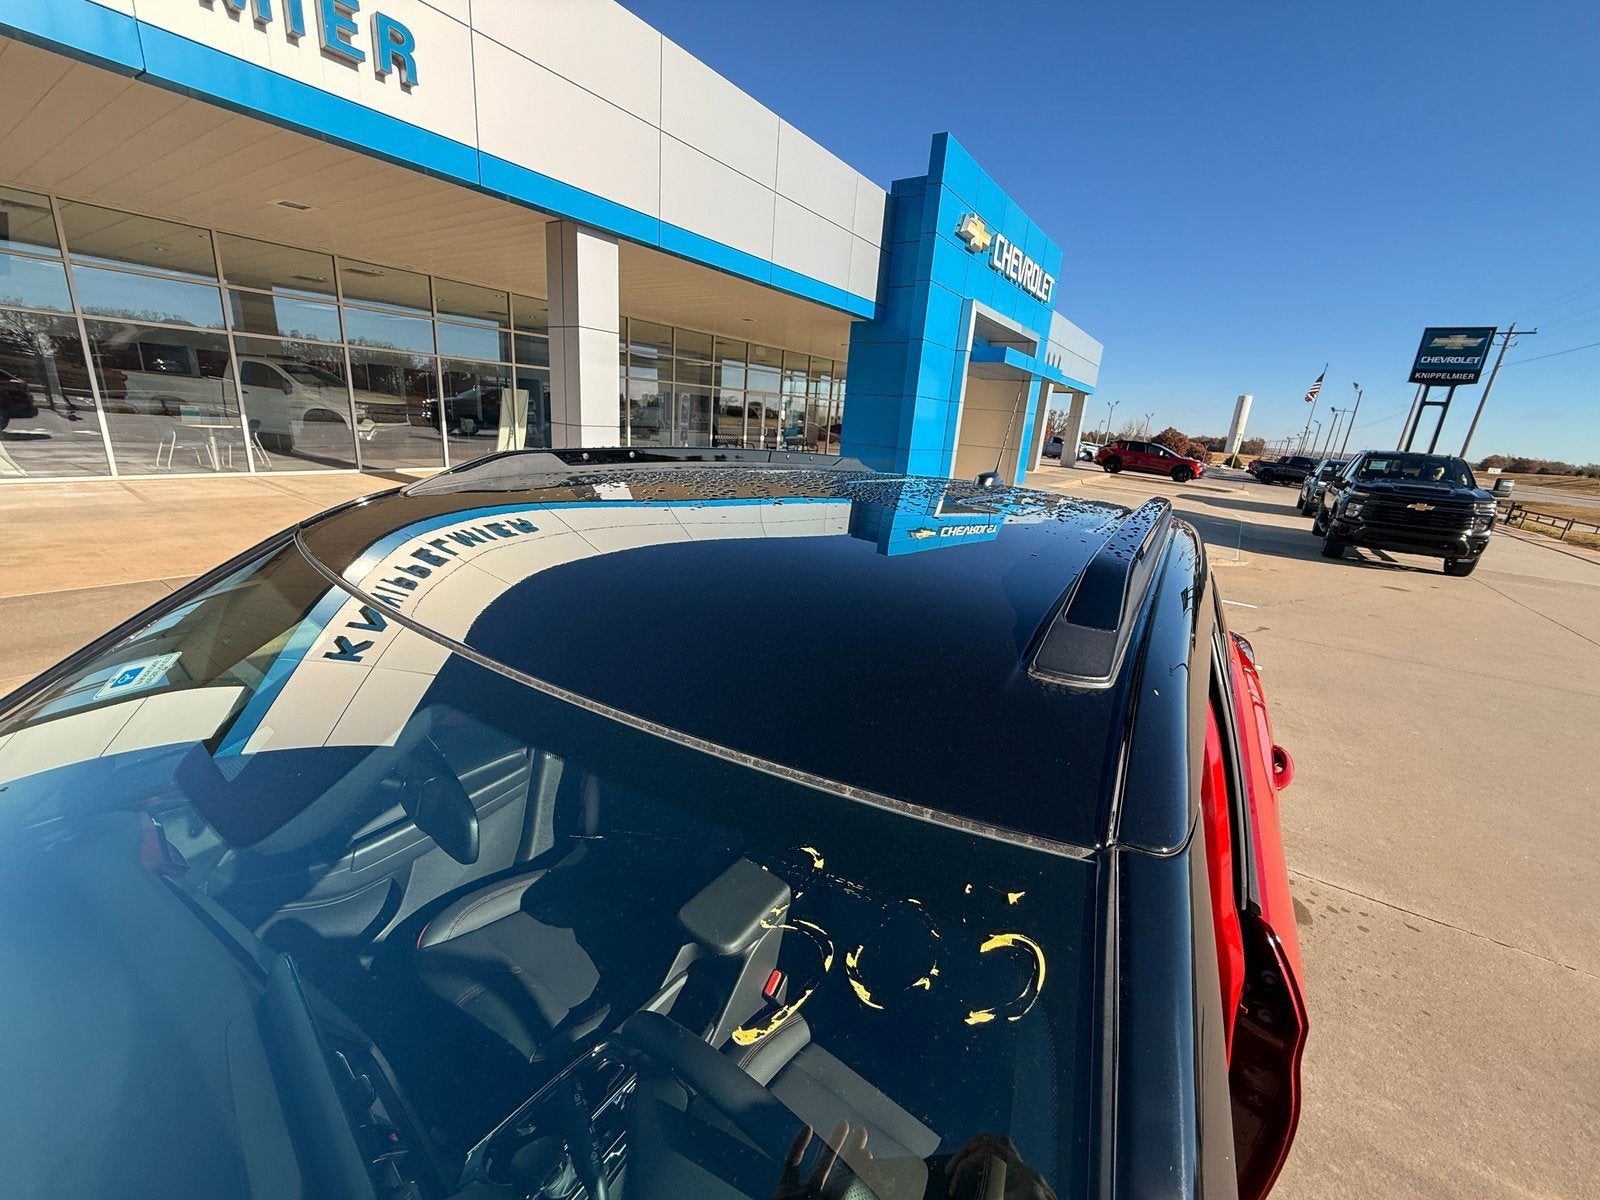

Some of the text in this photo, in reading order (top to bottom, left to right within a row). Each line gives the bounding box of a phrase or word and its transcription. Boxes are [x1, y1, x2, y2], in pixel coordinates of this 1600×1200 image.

[203, 0, 418, 86] IER
[990, 232, 1056, 303] CHEVROLET
[1414, 371, 1475, 380] KNIPPELMIER
[1420, 356, 1480, 364] CHEVROLET
